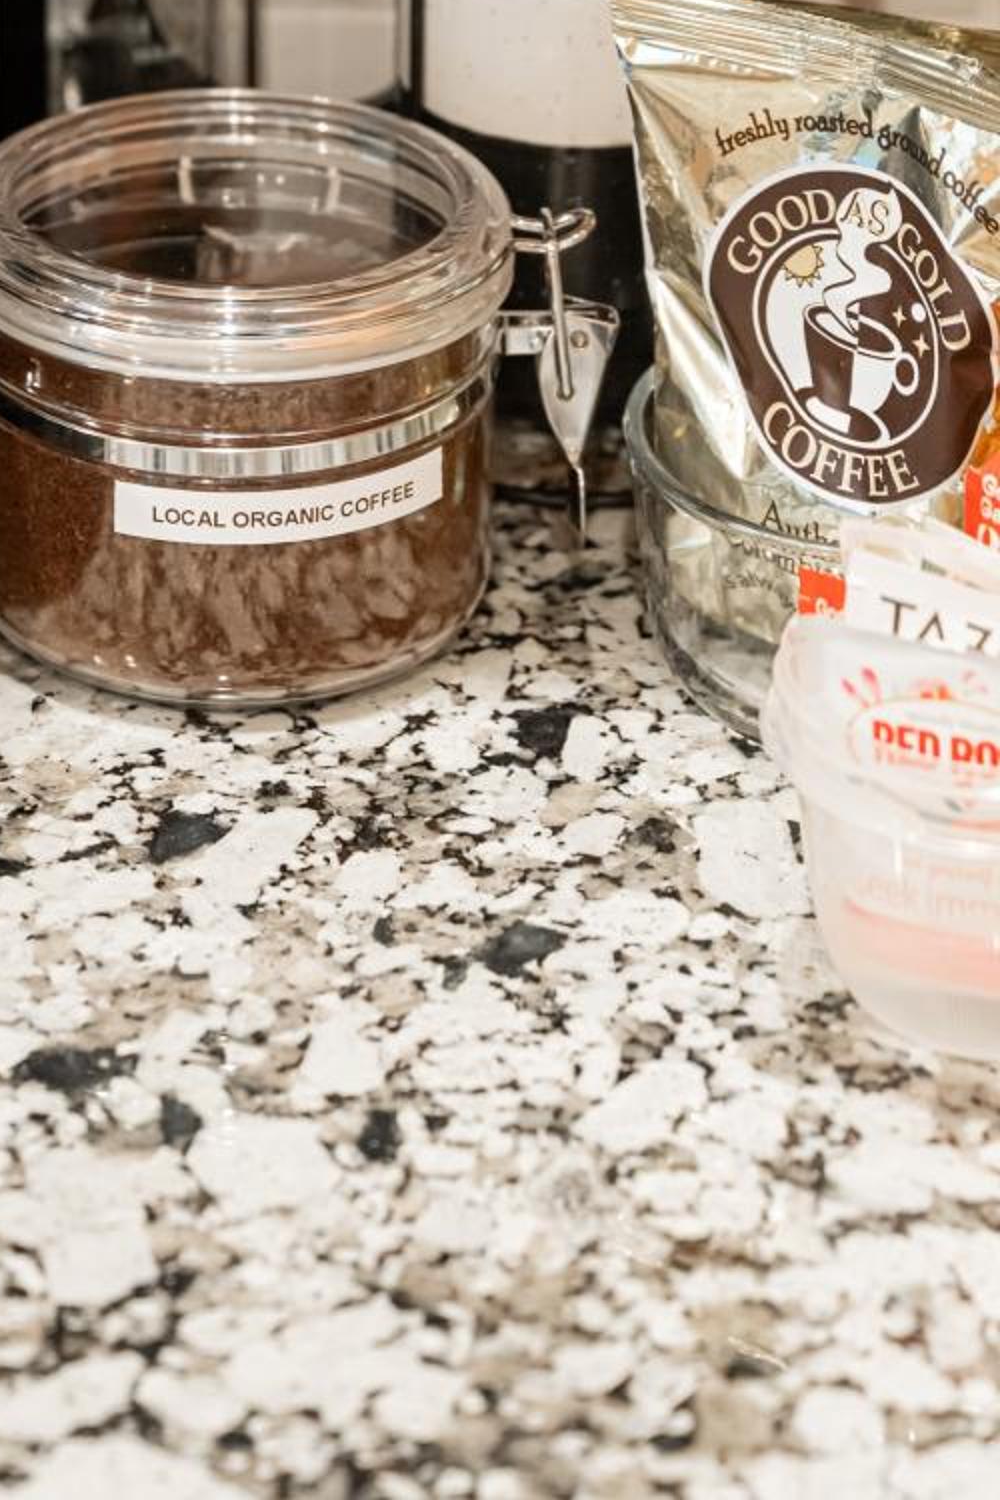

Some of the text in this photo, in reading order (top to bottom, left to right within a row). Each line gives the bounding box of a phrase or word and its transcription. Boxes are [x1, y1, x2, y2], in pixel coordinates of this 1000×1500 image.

[715, 108, 1000, 234] freshly roasted ground coffee
[727, 188, 972, 351] GOOD AS GOLD
[763, 401, 920, 497] COFFEE
[152, 481, 415, 529] LOCAL ORGANIC COFFEE
